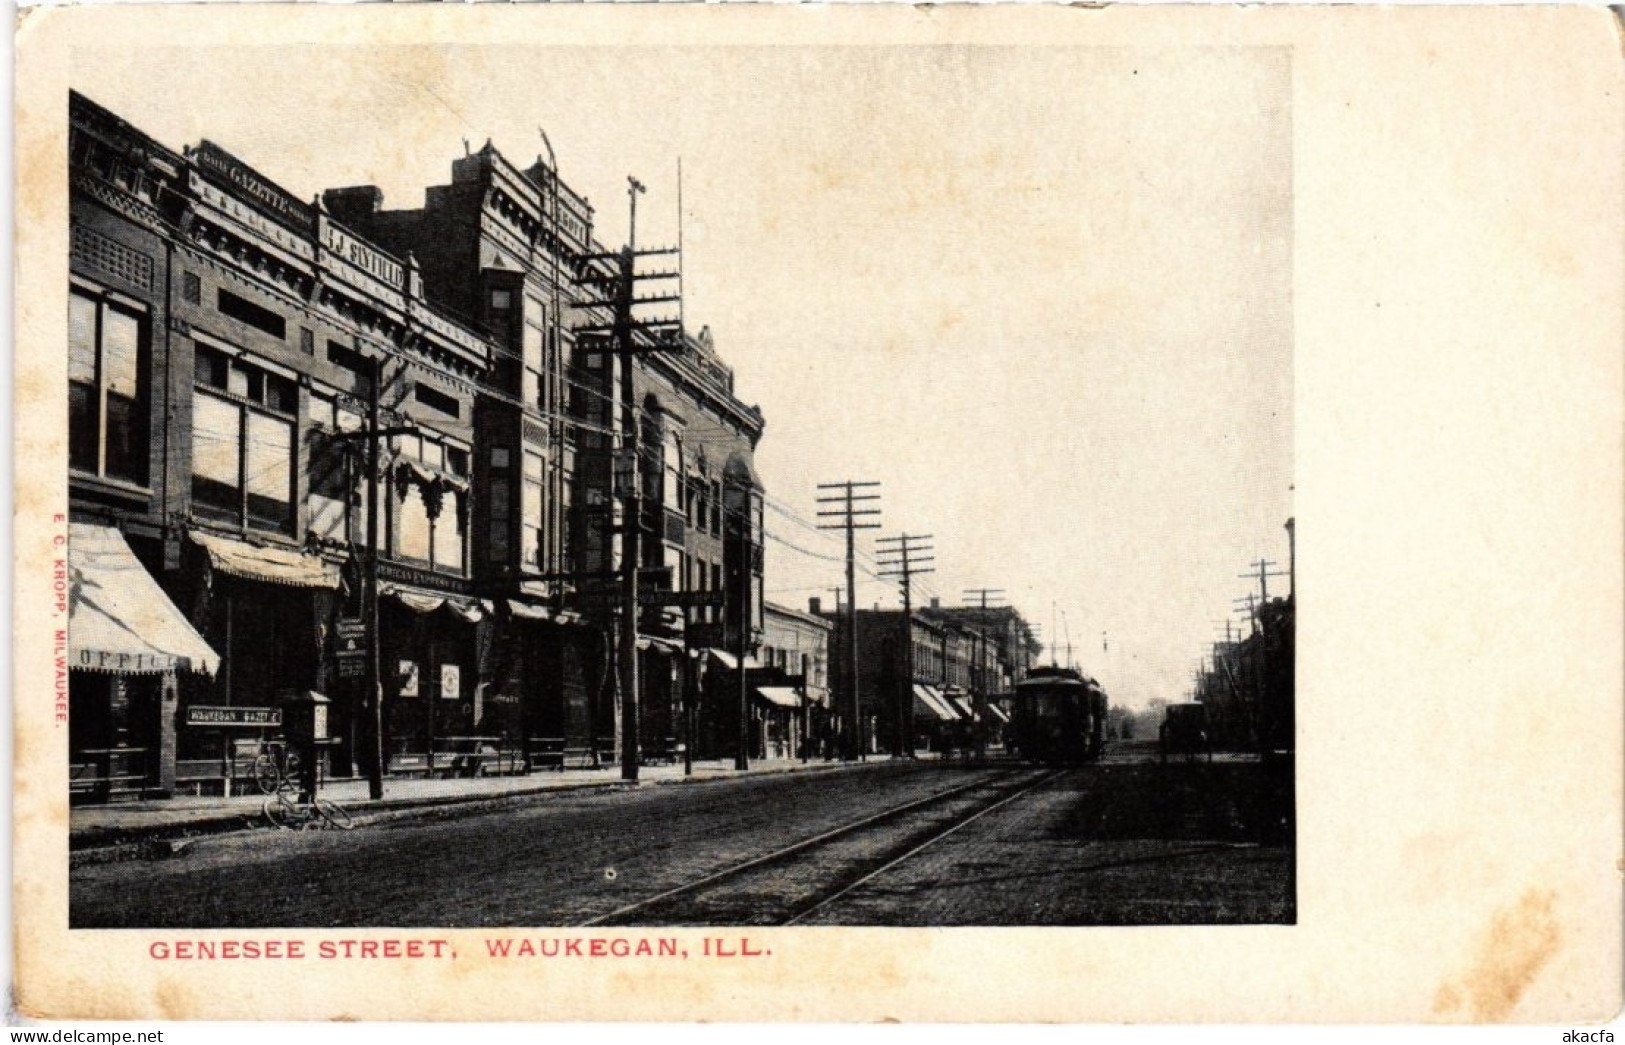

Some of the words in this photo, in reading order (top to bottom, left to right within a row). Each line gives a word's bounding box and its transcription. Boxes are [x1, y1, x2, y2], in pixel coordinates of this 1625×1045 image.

[230, 166, 288, 214] GAZETTE
[53, 558, 67, 618] KROPP,
[54, 629, 67, 729] MILWAUKEE.
[244, 711, 278, 722] GAZETE
[149, 940, 305, 960] GENESEE
[318, 939, 458, 960] STREET,
[485, 938, 689, 960] WAUKEGAN,
[703, 938, 773, 957] ILL.
